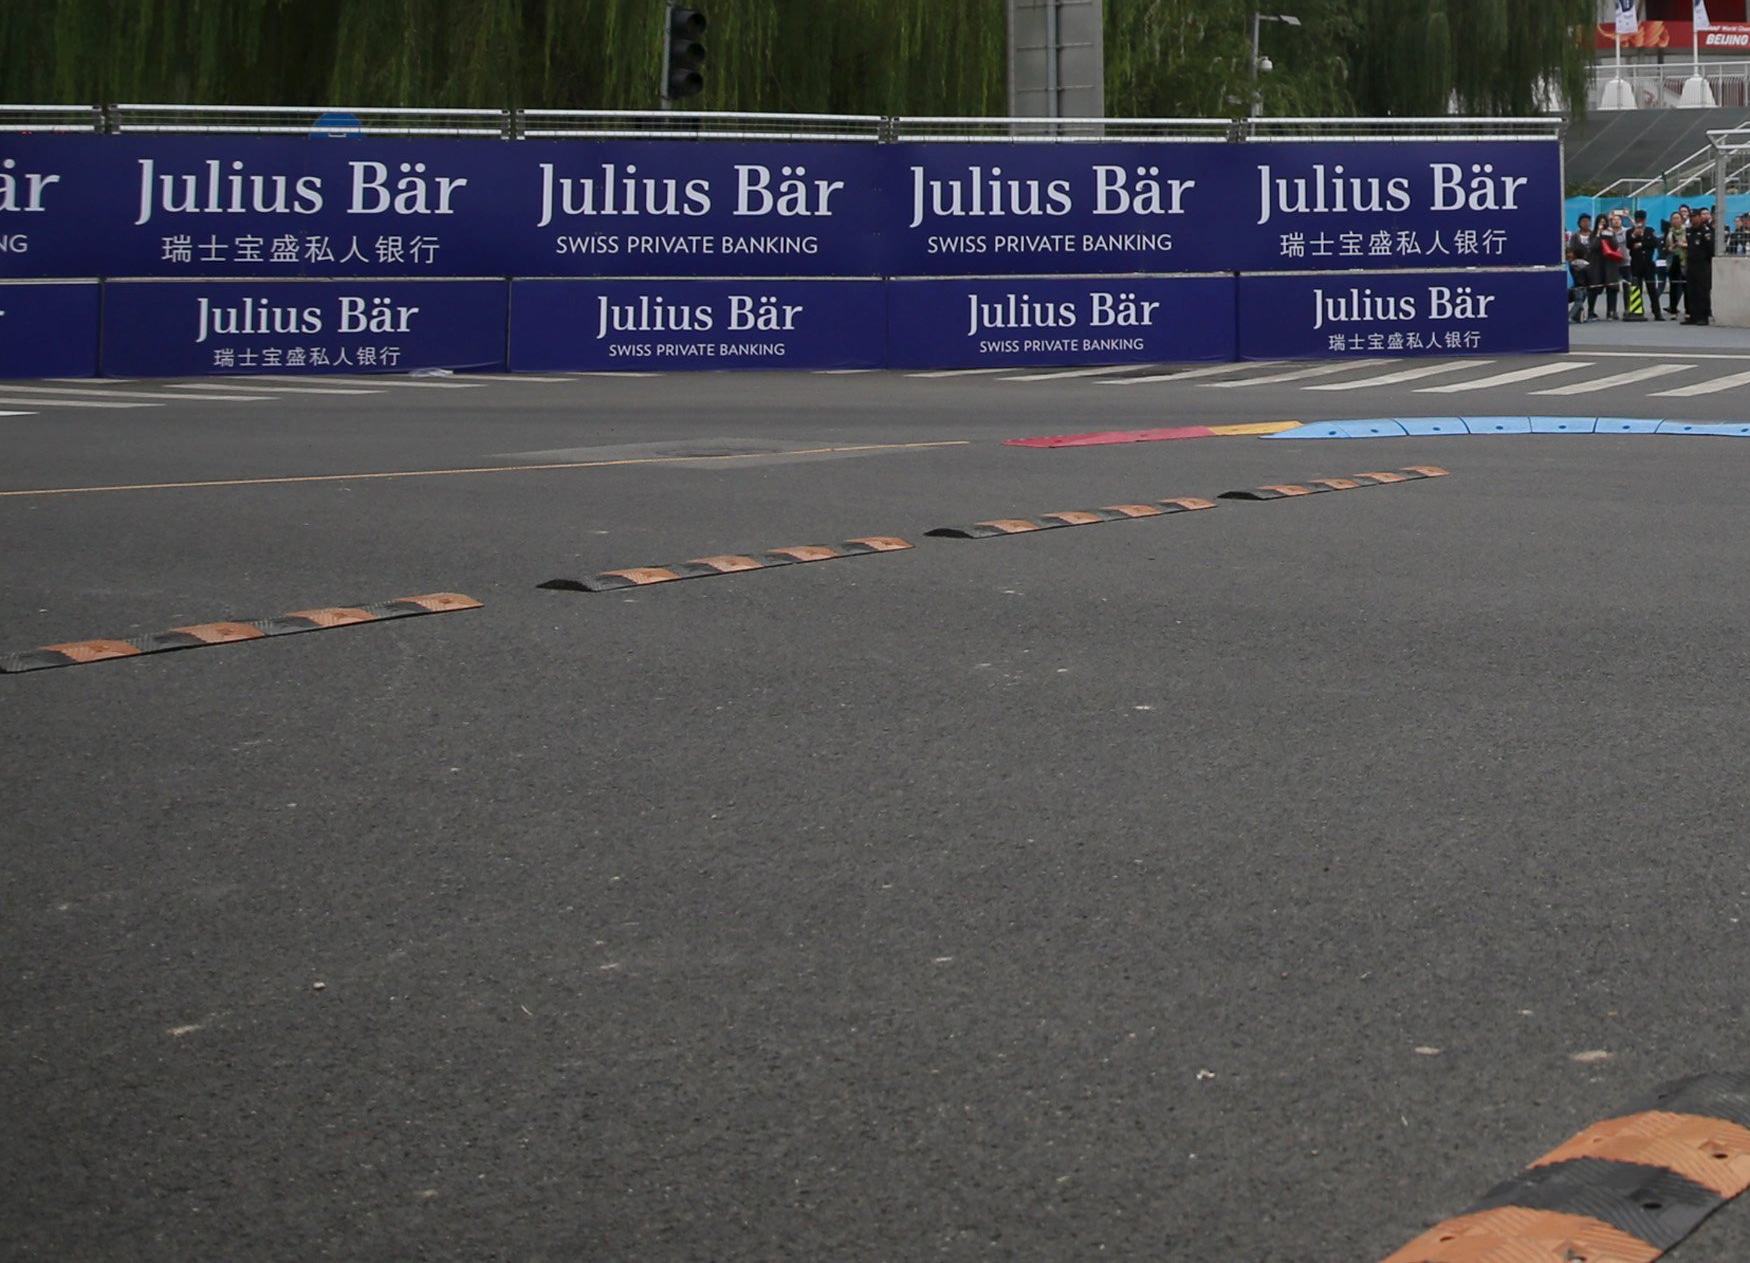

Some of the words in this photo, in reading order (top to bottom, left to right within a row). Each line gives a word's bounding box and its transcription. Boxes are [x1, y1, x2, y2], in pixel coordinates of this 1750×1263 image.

[1705, 33, 1749, 45] BEIJING
[0, 158, 61, 212] är
[134, 158, 323, 226] Julius
[346, 161, 468, 215] Bär
[536, 163, 711, 228] Julius
[732, 164, 845, 217] Bär
[909, 166, 1072, 228] Julius
[1092, 165, 1196, 215] Bär
[1256, 164, 1411, 225] Julius
[1429, 163, 1528, 211] Bär
[161, 233, 440, 264] 瑞士宝盛私人银行
[556, 235, 619, 254] SWISS
[627, 235, 714, 254] PRIVATE
[722, 236, 818, 254] BANKING
[927, 235, 987, 254] SWISS
[994, 234, 1076, 253] PRIVATE
[1082, 233, 1172, 252] BANKING
[1279, 228, 1508, 258] 瑞士宝盛私人银行
[195, 297, 322, 343] Julius
[337, 296, 420, 333] Bär
[596, 295, 713, 340] Julius
[727, 295, 804, 331] Bär
[967, 293, 1077, 337] Julius
[1089, 292, 1160, 326] Bär
[1313, 288, 1416, 335] Julius
[1428, 286, 1496, 320] Bär
[213, 346, 401, 367] 瑞士宝盛私人银行
[608, 343, 652, 357] SWISS
[656, 343, 715, 356] PRIVATE
[719, 343, 785, 356] BANKING
[979, 340, 1020, 353] SWISS
[1024, 339, 1079, 352] PRIVATE
[1082, 337, 1144, 351] BANKING
[1328, 330, 1481, 351] 瑞士宝盛私人银行
